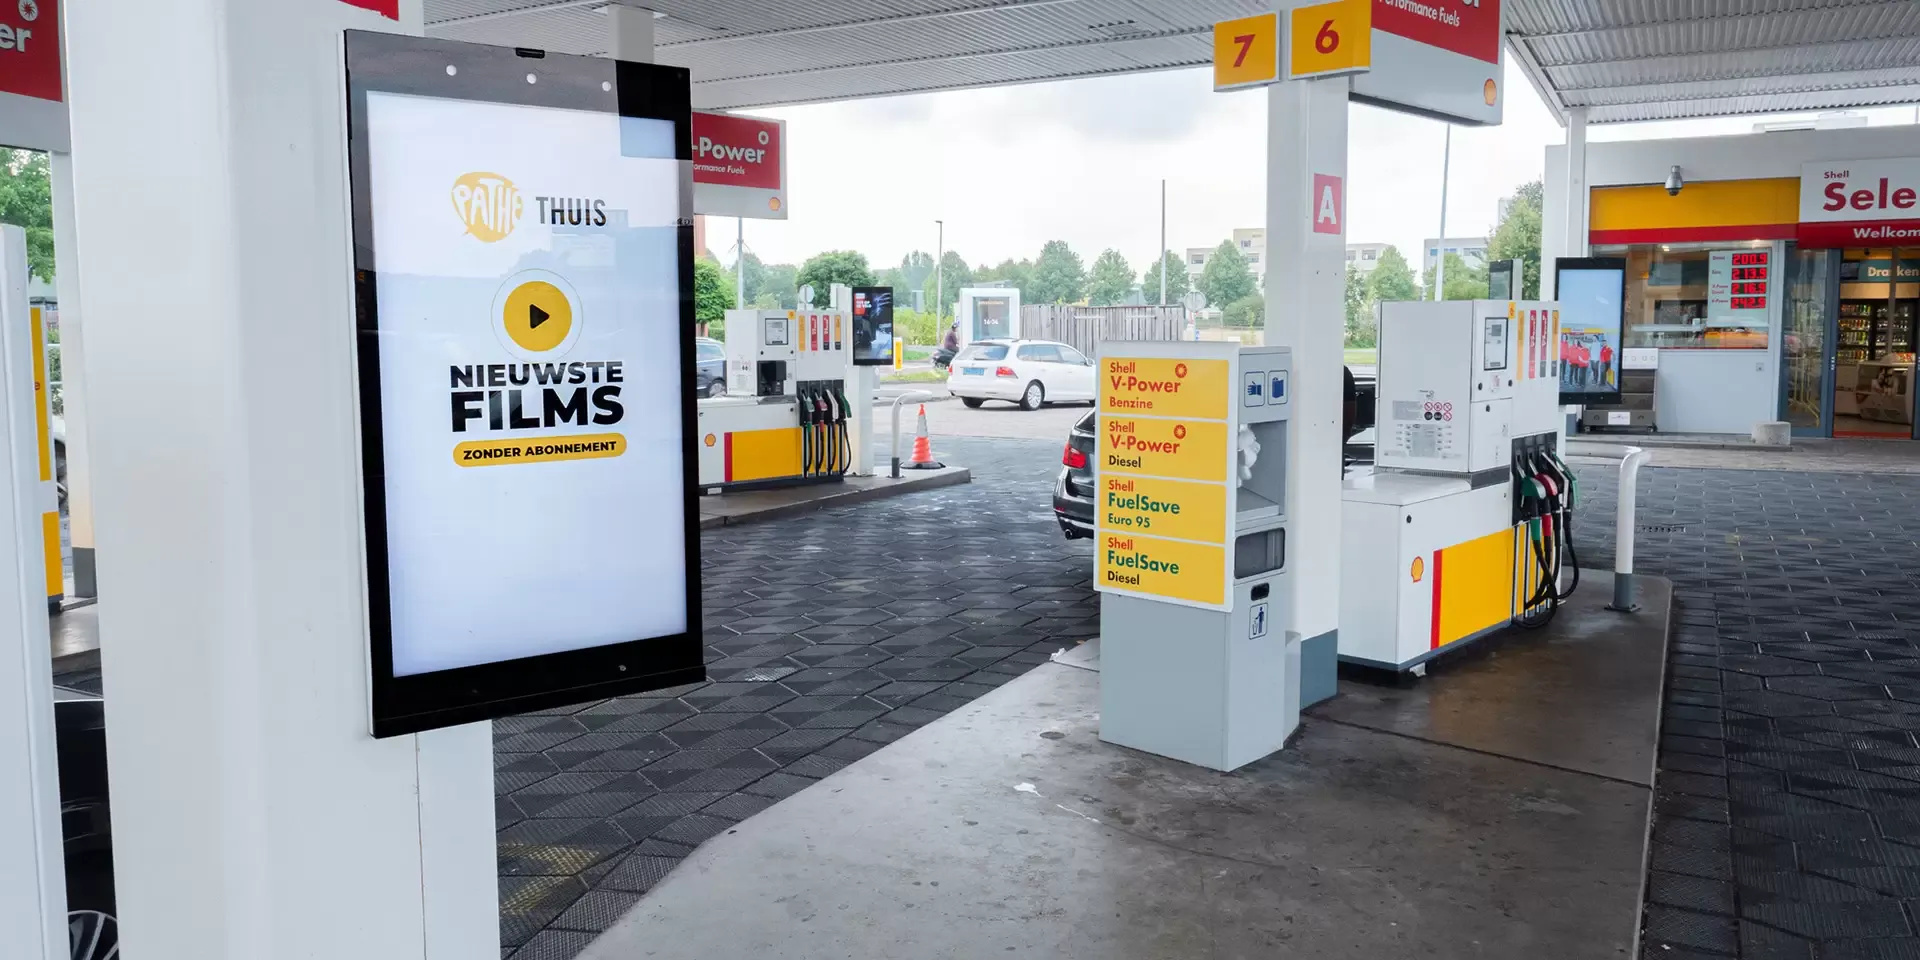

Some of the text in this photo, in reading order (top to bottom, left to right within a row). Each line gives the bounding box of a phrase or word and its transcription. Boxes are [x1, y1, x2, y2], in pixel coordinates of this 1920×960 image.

[1439, 6, 1460, 27] Fuels
[1315, 19, 1339, 55] 6
[1233, 34, 1256, 68] 7
[727, 164, 745, 174] Fuels
[1824, 170, 1850, 179] Shell
[1823, 177, 1920, 212] Sele
[535, 196, 607, 227] THUIS
[1317, 185, 1337, 224] A
[450, 361, 623, 388] NIEUWSTE
[1110, 362, 1136, 374] Shell
[1111, 376, 1181, 393] V-Power
[451, 385, 624, 432] FILMS
[1109, 396, 1153, 409] Benzine
[1109, 421, 1135, 433] Shell
[463, 441, 617, 460] ZONDER ABONNEMENT
[1110, 434, 1180, 454] V-Power
[1109, 455, 1142, 468] Diesel
[1108, 479, 1134, 492] Shell
[1108, 492, 1180, 514] FuelSave
[1108, 513, 1150, 528] Euro 95
[1107, 537, 1133, 550] Shell
[1107, 550, 1179, 574] FuelSave
[1107, 571, 1140, 585] Diesel
